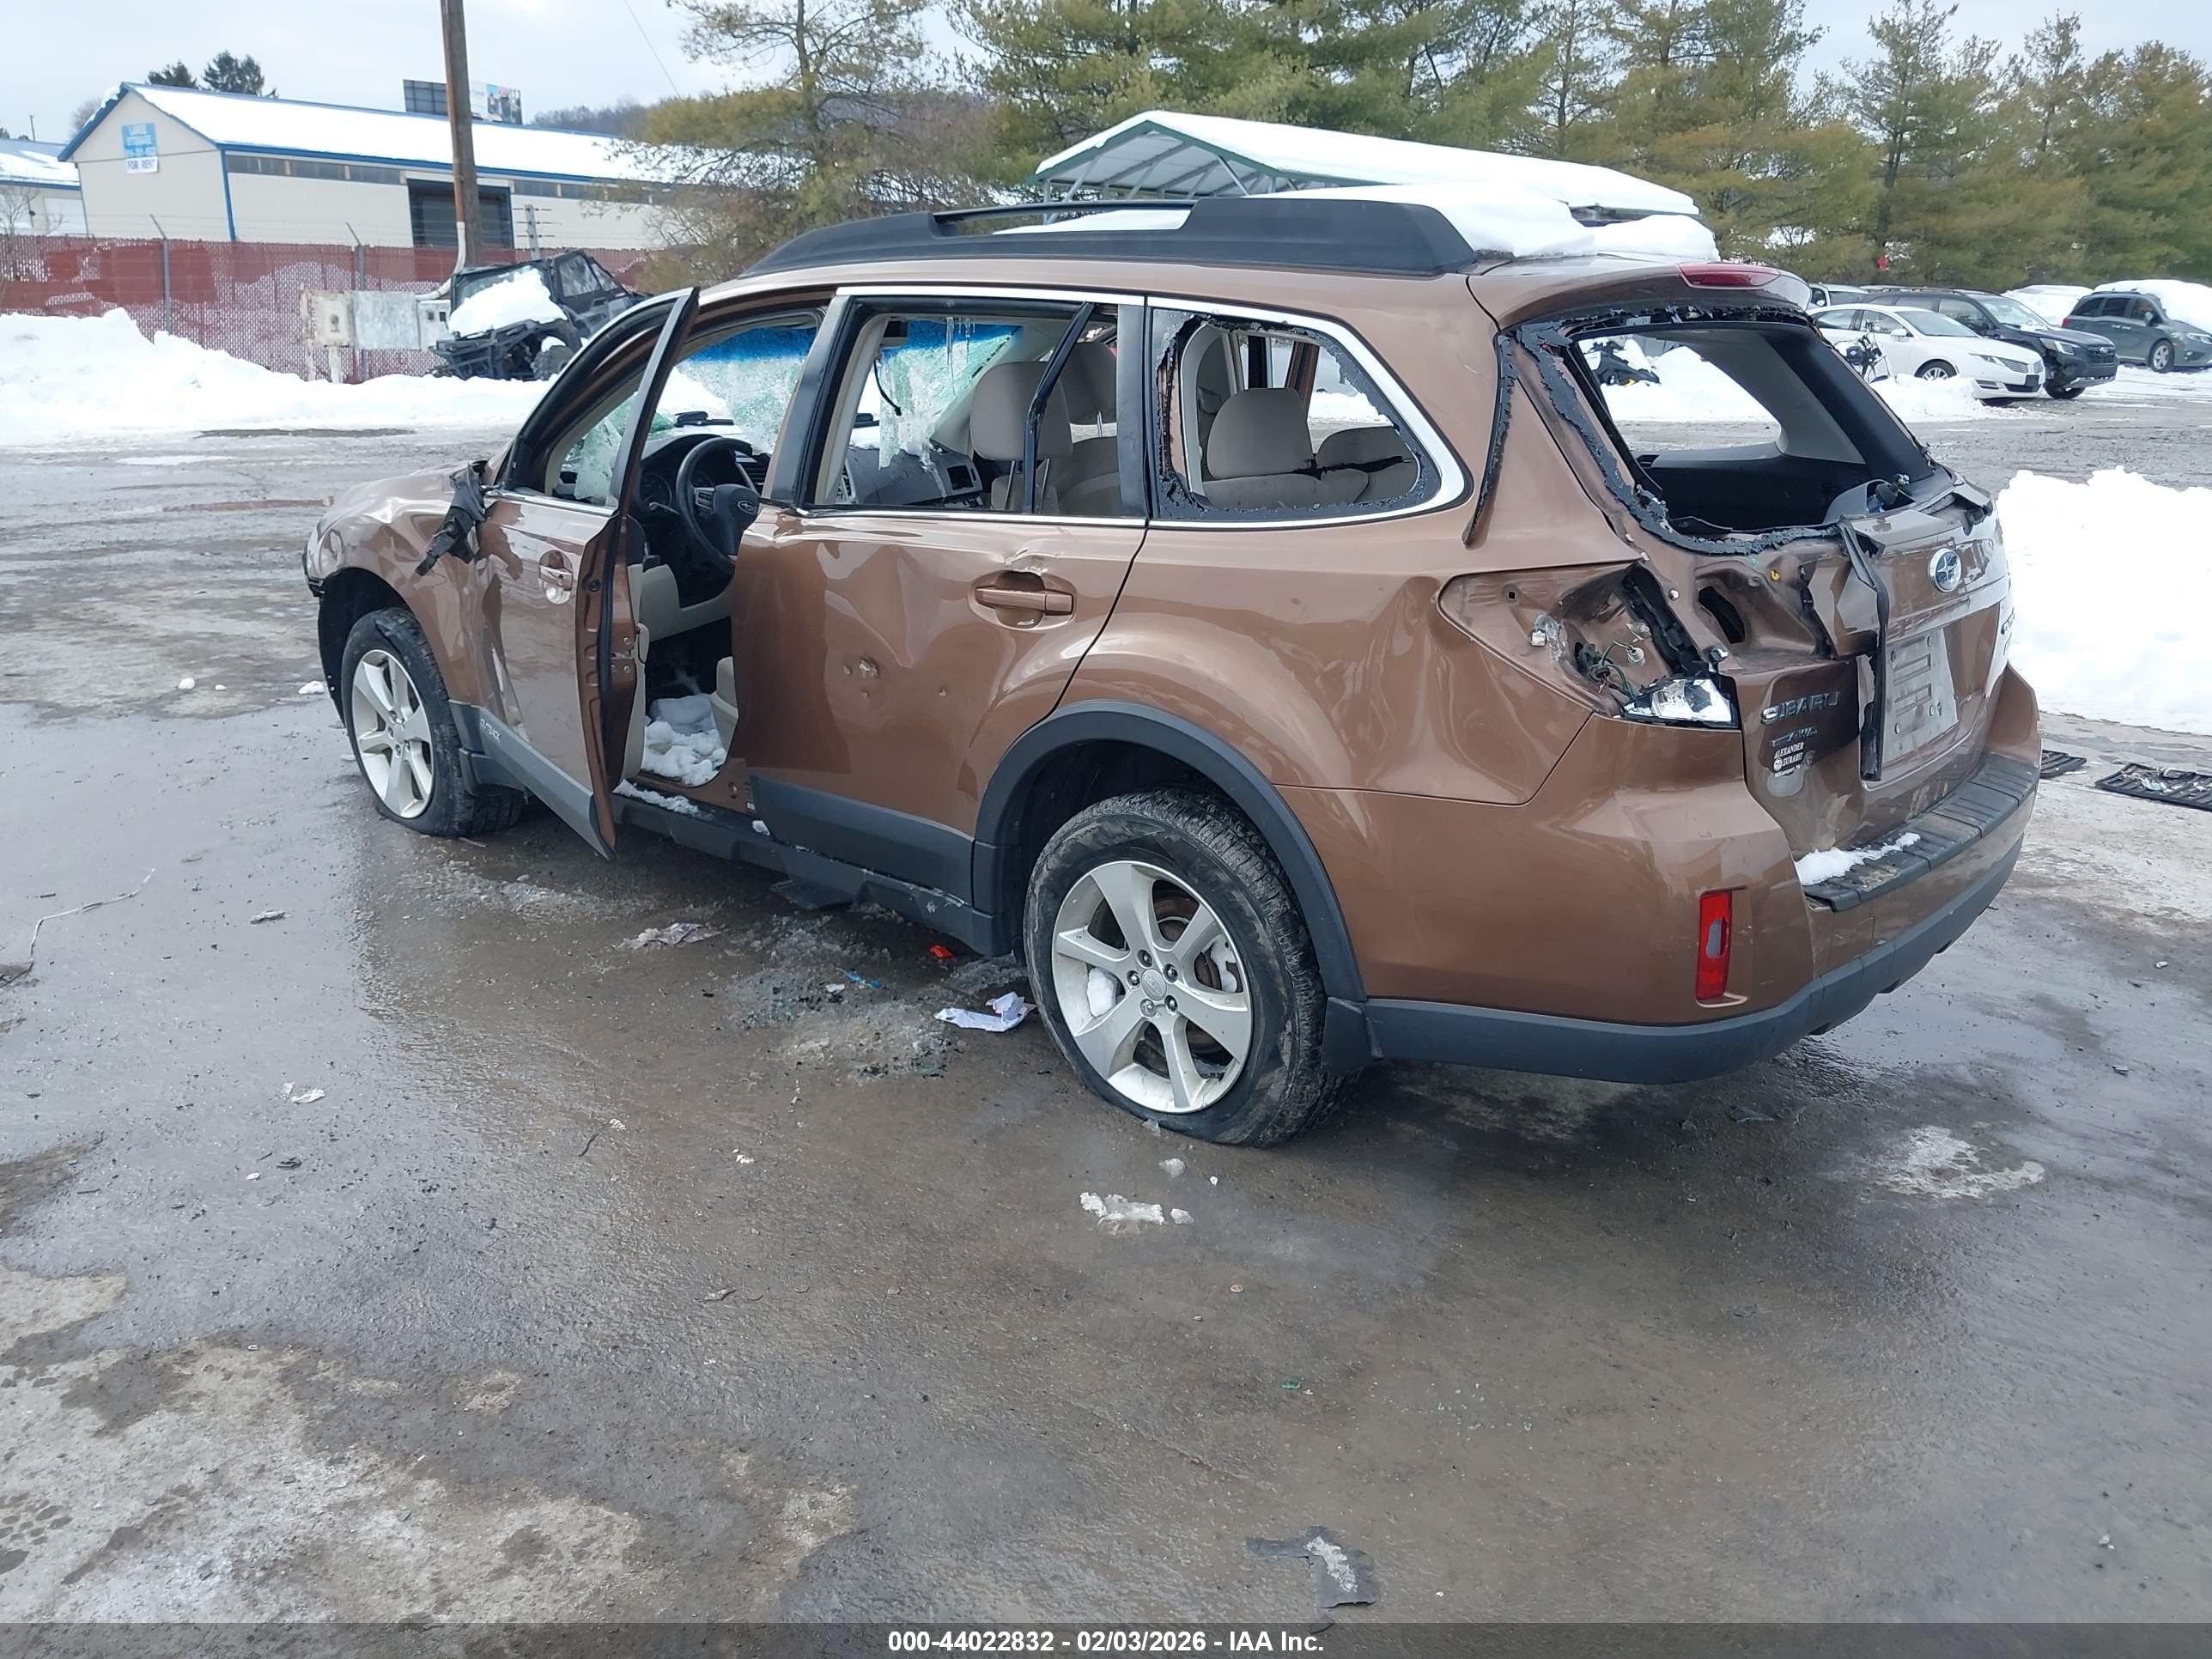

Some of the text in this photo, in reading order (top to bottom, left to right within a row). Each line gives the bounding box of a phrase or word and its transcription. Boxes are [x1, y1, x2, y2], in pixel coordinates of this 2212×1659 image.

[127, 159, 155, 170] FOR RENT
[1760, 691, 1840, 726] SUBARU
[1773, 741, 1805, 759] ALEXANDER
[1782, 751, 1804, 767] SUBARU
